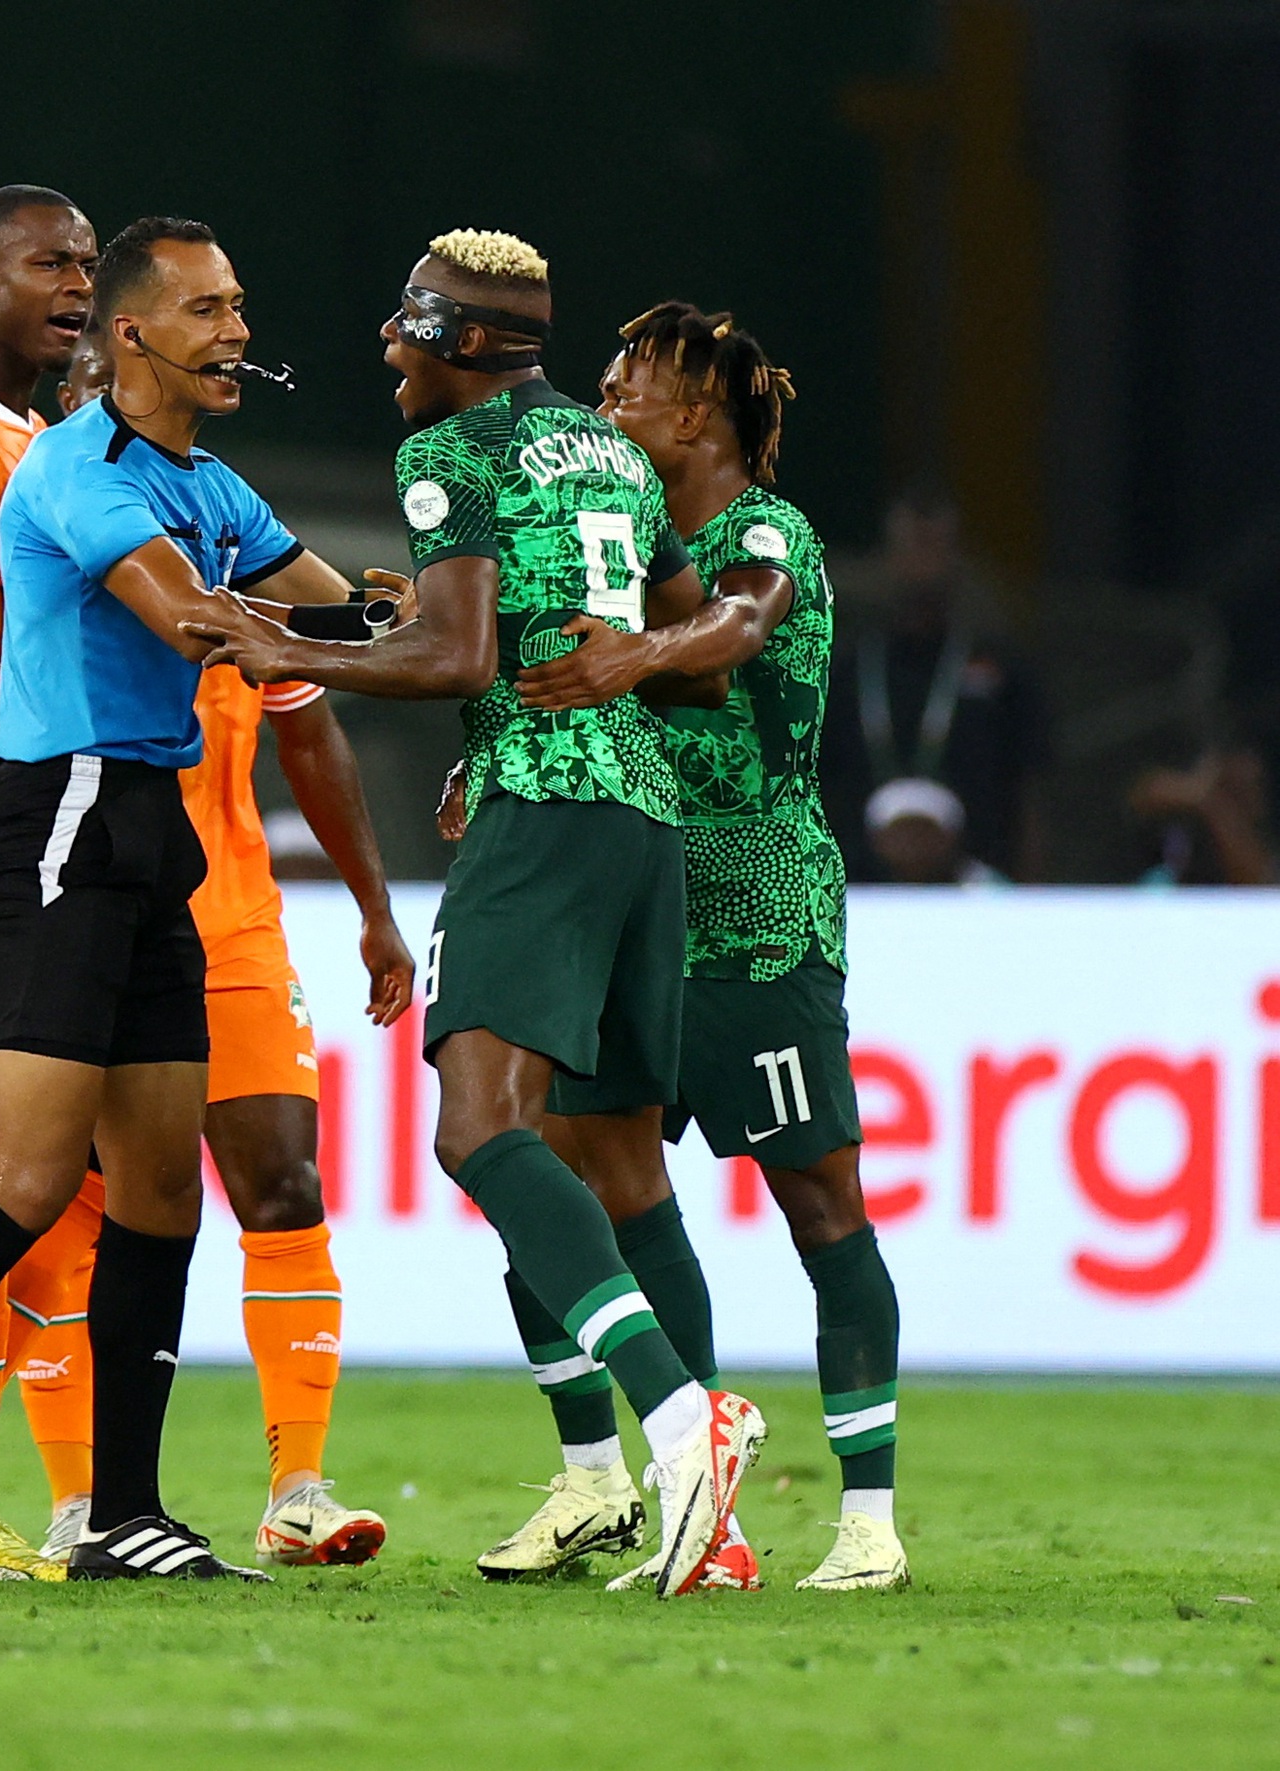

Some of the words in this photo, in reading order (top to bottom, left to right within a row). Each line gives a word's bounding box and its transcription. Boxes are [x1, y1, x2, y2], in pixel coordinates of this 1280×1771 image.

[414, 326, 442, 340] VO9
[519, 432, 646, 493] OSIMHEN
[753, 1046, 812, 1125] 11
